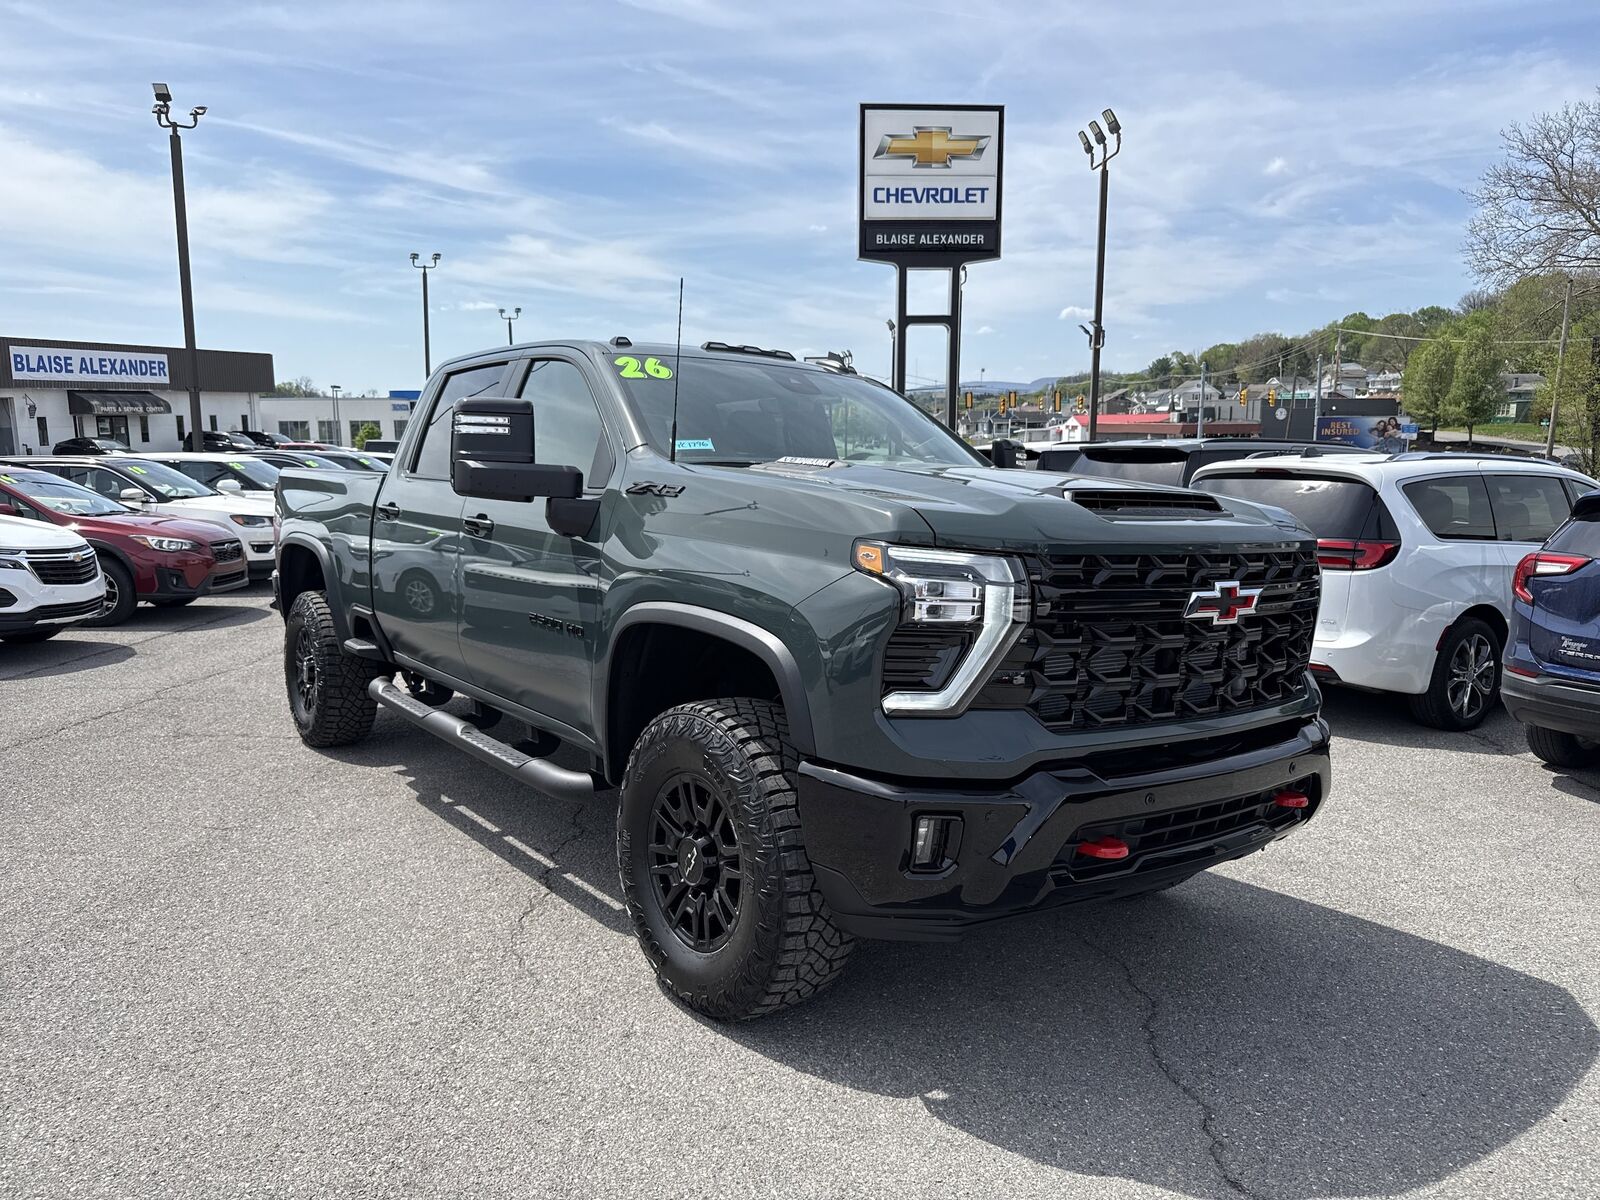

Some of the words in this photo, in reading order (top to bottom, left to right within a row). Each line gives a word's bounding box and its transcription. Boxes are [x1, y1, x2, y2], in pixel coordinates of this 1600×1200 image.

[873, 187, 989, 204] CHEVROLET
[876, 234, 916, 245] BLAISE
[919, 234, 985, 245] ALEXANDER
[13, 354, 73, 373] BLAISE
[79, 357, 167, 376] ALEXANDER
[614, 356, 673, 380] 26
[1321, 428, 1361, 436] INSURED
[625, 480, 687, 498] ZR2
